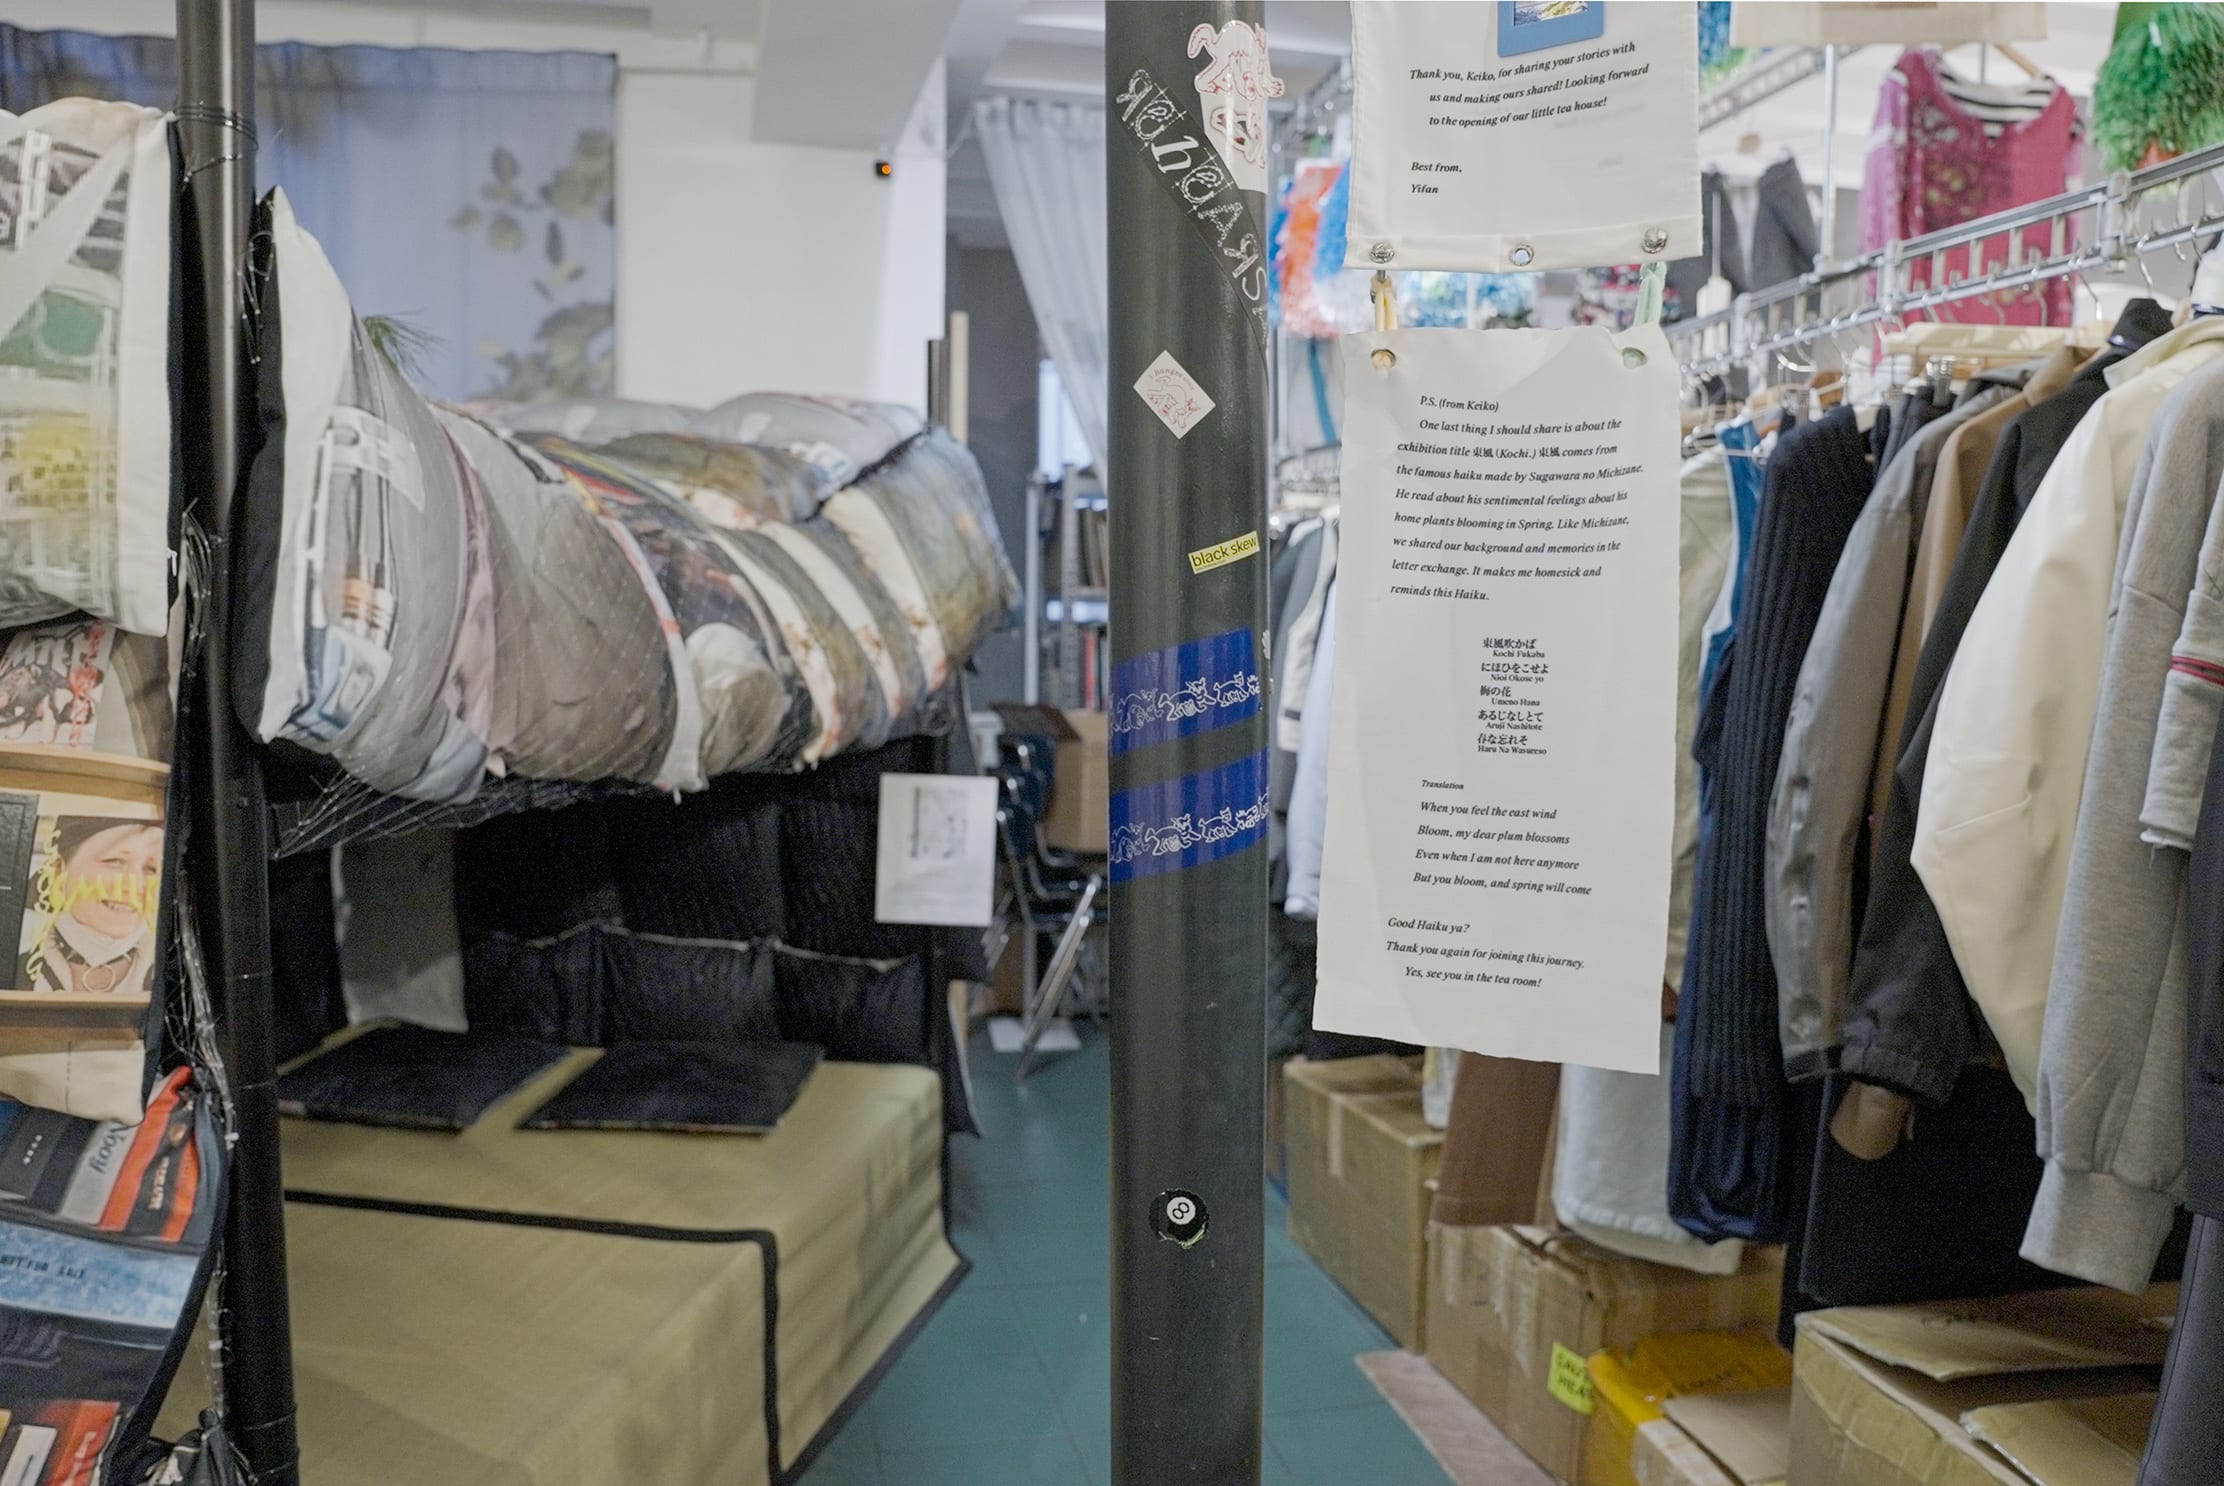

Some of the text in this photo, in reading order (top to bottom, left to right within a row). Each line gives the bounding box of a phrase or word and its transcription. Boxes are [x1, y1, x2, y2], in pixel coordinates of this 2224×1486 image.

[1410, 69, 1441, 79] Thank
[1442, 72, 1463, 81] you,
[1498, 66, 1512, 79] for
[1514, 61, 1551, 75] sharing
[1552, 56, 1575, 70] your
[1577, 49, 1610, 62] stories
[1613, 42, 1635, 55] with
[1429, 64, 1649, 104] us and making ours shared! Looking forward
[1429, 97, 1607, 128] to the opening of our little tea house!
[1411, 162, 1433, 171] Best
[1412, 184, 1438, 193] Yifan
[1439, 399, 1464, 409] (from
[1467, 401, 1499, 413] Keiko)
[1420, 419, 1622, 436] One last thing I should share is about the
[1397, 442, 1447, 455] exhibition
[1450, 446, 1470, 456] title
[1562, 448, 1593, 456] comes
[1595, 445, 1617, 455] from
[1397, 465, 1413, 475] the
[1414, 466, 1451, 479] famous
[1453, 469, 1482, 480] haiku
[1484, 472, 1513, 481] made
[1515, 472, 1527, 483] by
[1529, 472, 1580, 483] Sugawara
[1396, 488, 1627, 507] He read about his sentimental feelings about his
[1395, 512, 1421, 523] home
[1422, 515, 1455, 526] plants
[1456, 517, 1504, 530] blooming
[1506, 520, 1516, 528] in
[1557, 519, 1579, 528] Like
[1191, 546, 1230, 567] black
[1230, 536, 1257, 555] skew
[1394, 538, 1407, 546] we
[1408, 538, 1443, 549] shared
[1464, 542, 1523, 554] background
[1525, 544, 1546, 553] and
[1547, 543, 1595, 553] memories
[1596, 543, 1606, 552] in
[1607, 541, 1621, 551] the
[1392, 560, 1419, 571] letter
[1420, 563, 1469, 576] exchange.
[1473, 566, 1481, 575] It
[1483, 567, 1515, 576] makes
[1535, 567, 1581, 577] homesick
[1583, 566, 1602, 576] and
[1391, 585, 1489, 600] reminds this Haiku.
[1422, 780, 1464, 789] Translation
[1421, 801, 1557, 819] When you feel the east wind
[1418, 825, 1570, 844] Bloom, my dear plum blossoms
[1416, 849, 1439, 860] Even
[1442, 851, 1468, 862] when
[1470, 853, 1475, 862] I
[1494, 856, 1512, 864] not
[1513, 856, 1535, 866] here
[1537, 860, 1579, 870] anymore
[1413, 872, 1591, 895] But you bloom, and spring will come
[1388, 918, 1470, 934] Good Haiku ya?
[1387, 941, 1583, 970] Thank you again for joining this journey.
[1406, 966, 1423, 978] Yes,
[1442, 972, 1462, 981] you
[1464, 972, 1474, 981] in
[1476, 973, 1493, 982] the
[1495, 975, 1510, 984] tea
[1512, 978, 1542, 987] room!
[1172, 1202, 1190, 1220] 8
